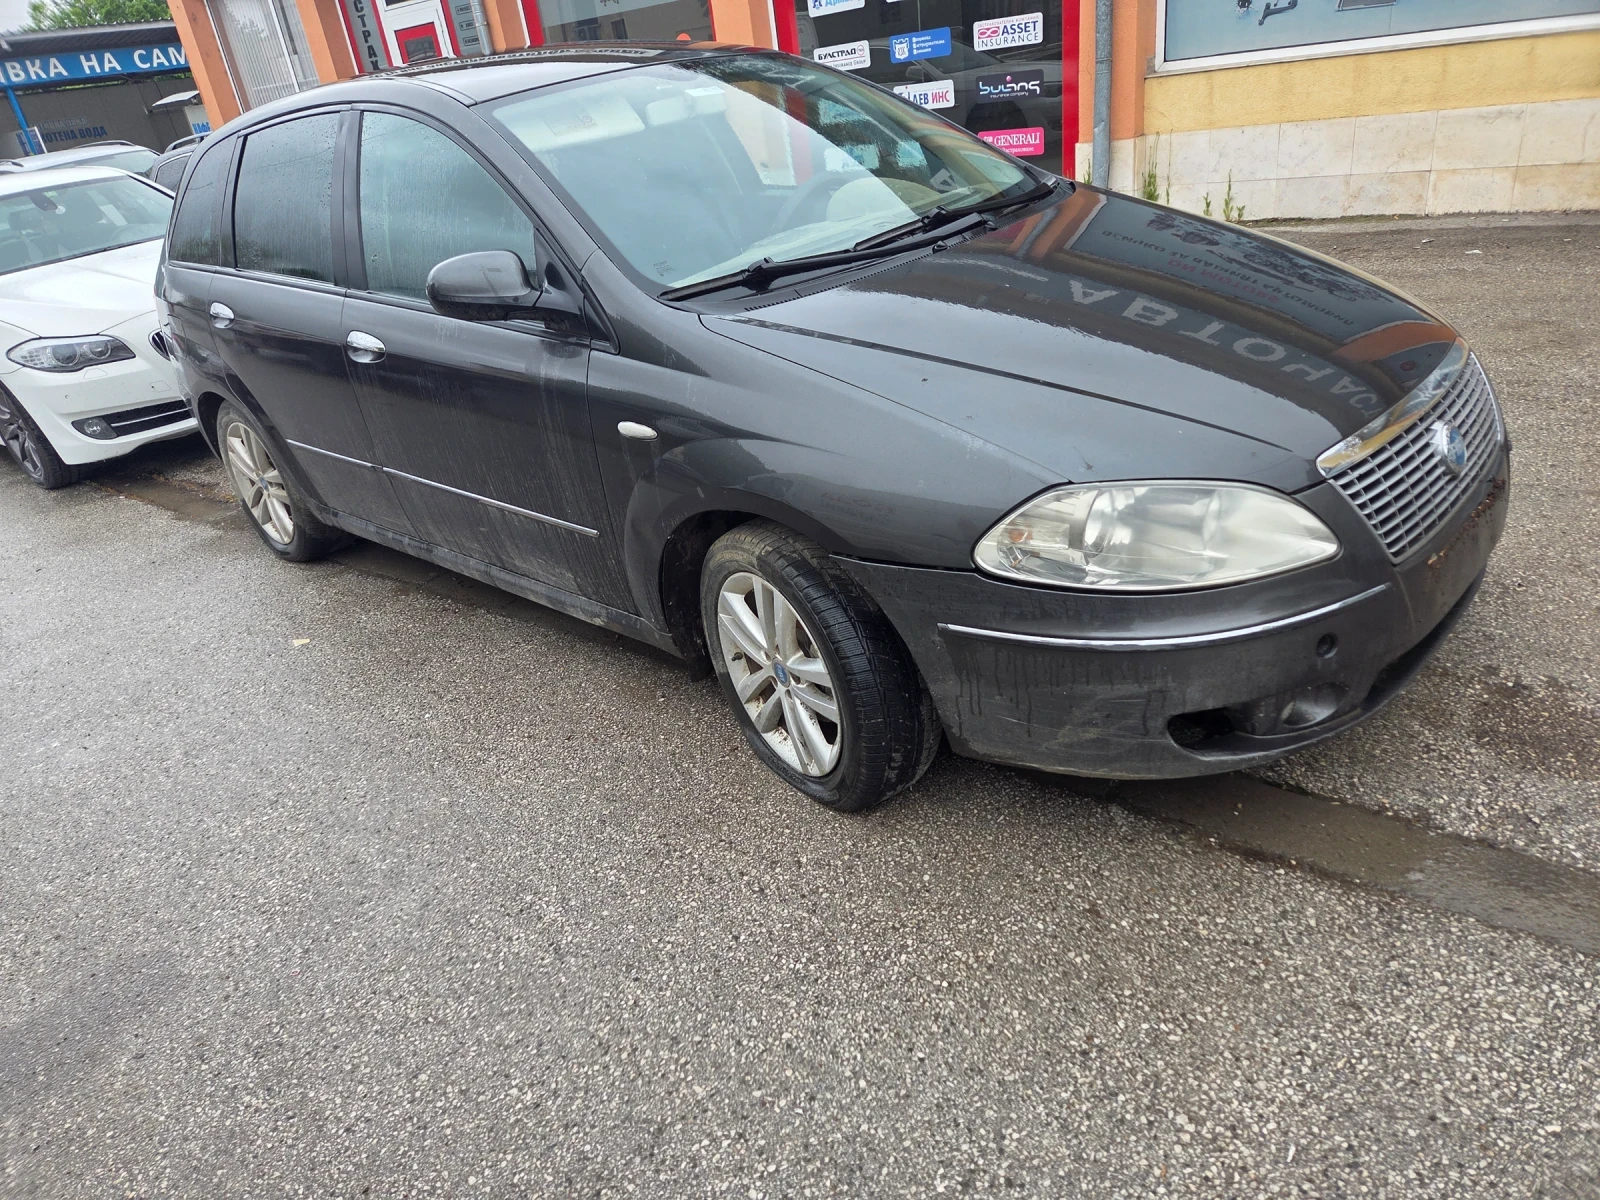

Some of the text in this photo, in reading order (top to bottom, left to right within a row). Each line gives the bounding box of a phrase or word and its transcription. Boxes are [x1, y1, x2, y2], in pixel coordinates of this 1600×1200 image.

[1002, 21, 1039, 36] ASSET
[978, 32, 1039, 48] INSURANCE
[818, 48, 856, 60] БУЛСТРАД
[80, 52, 122, 74] НА
[912, 90, 950, 105] ЛЕВ ИНС
[78, 126, 108, 139] ВОДА
[994, 133, 1041, 147] GENERALI
